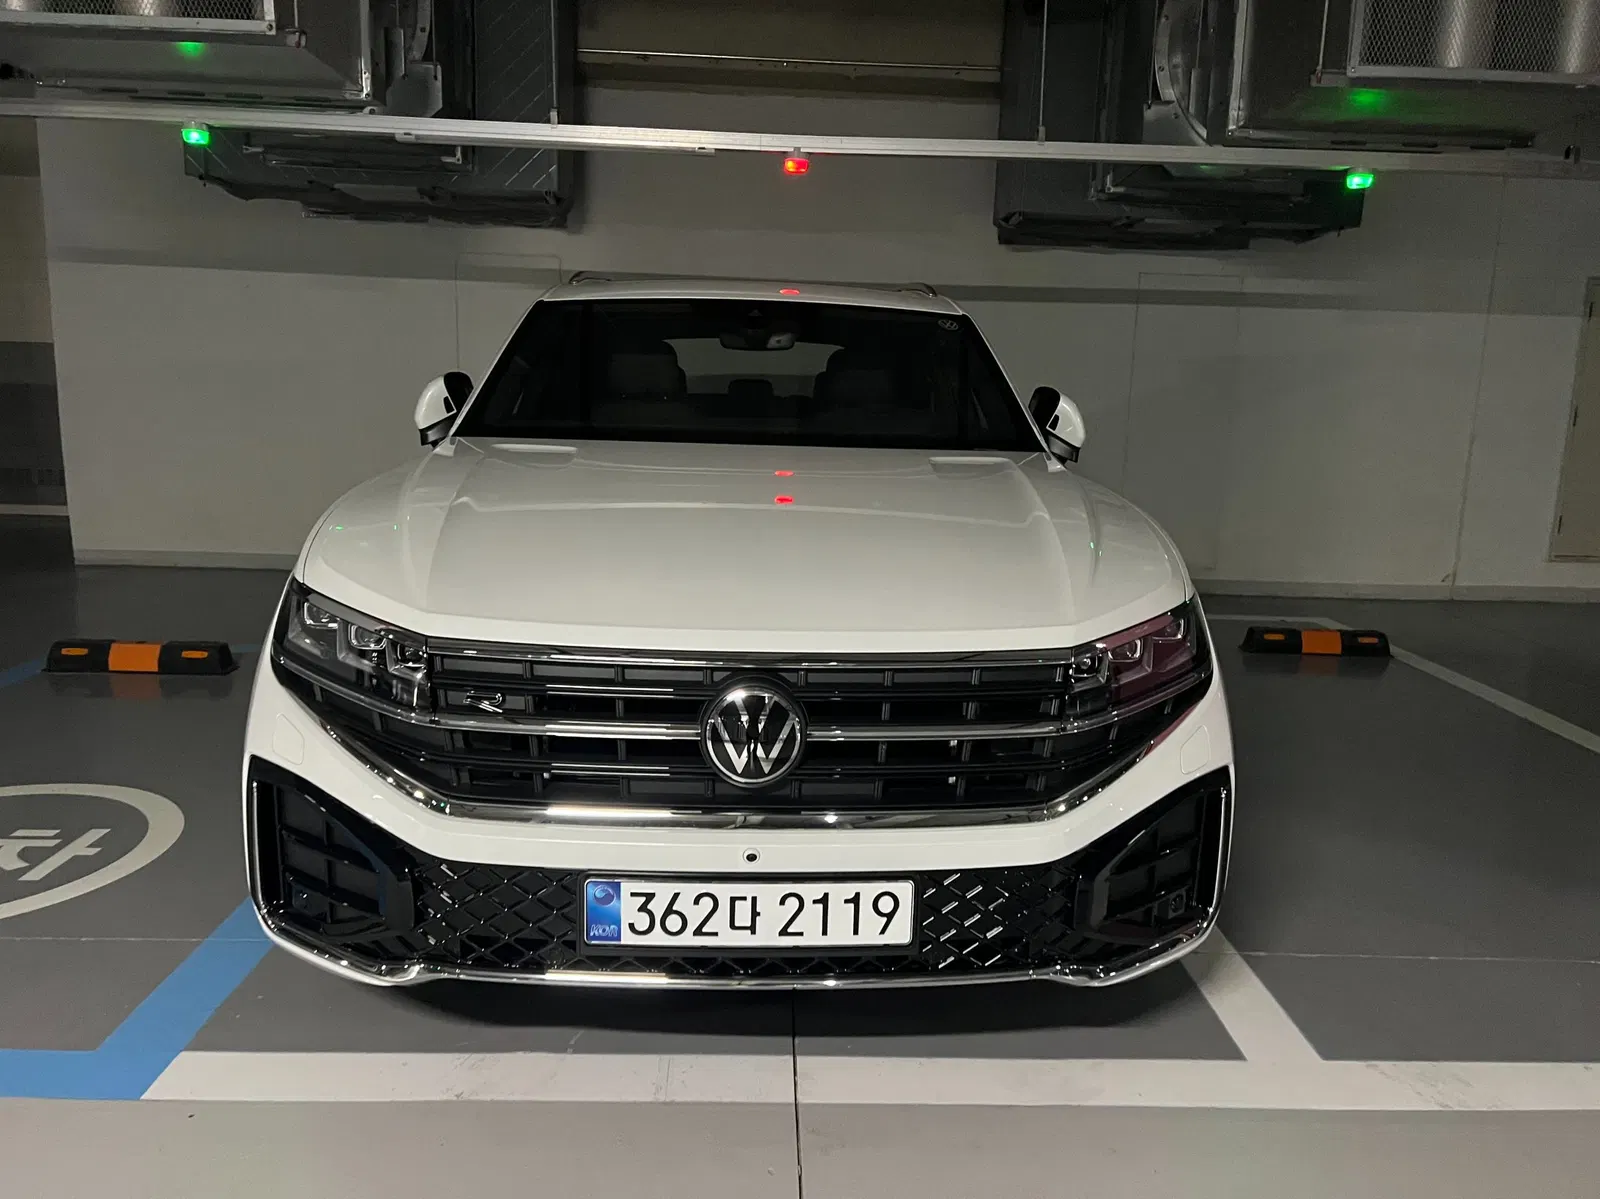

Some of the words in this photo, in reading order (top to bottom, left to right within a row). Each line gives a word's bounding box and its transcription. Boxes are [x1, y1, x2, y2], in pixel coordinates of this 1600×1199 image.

[627, 891, 761, 937] 362다
[777, 891, 900, 937] 2119
[589, 924, 619, 937] KOR
